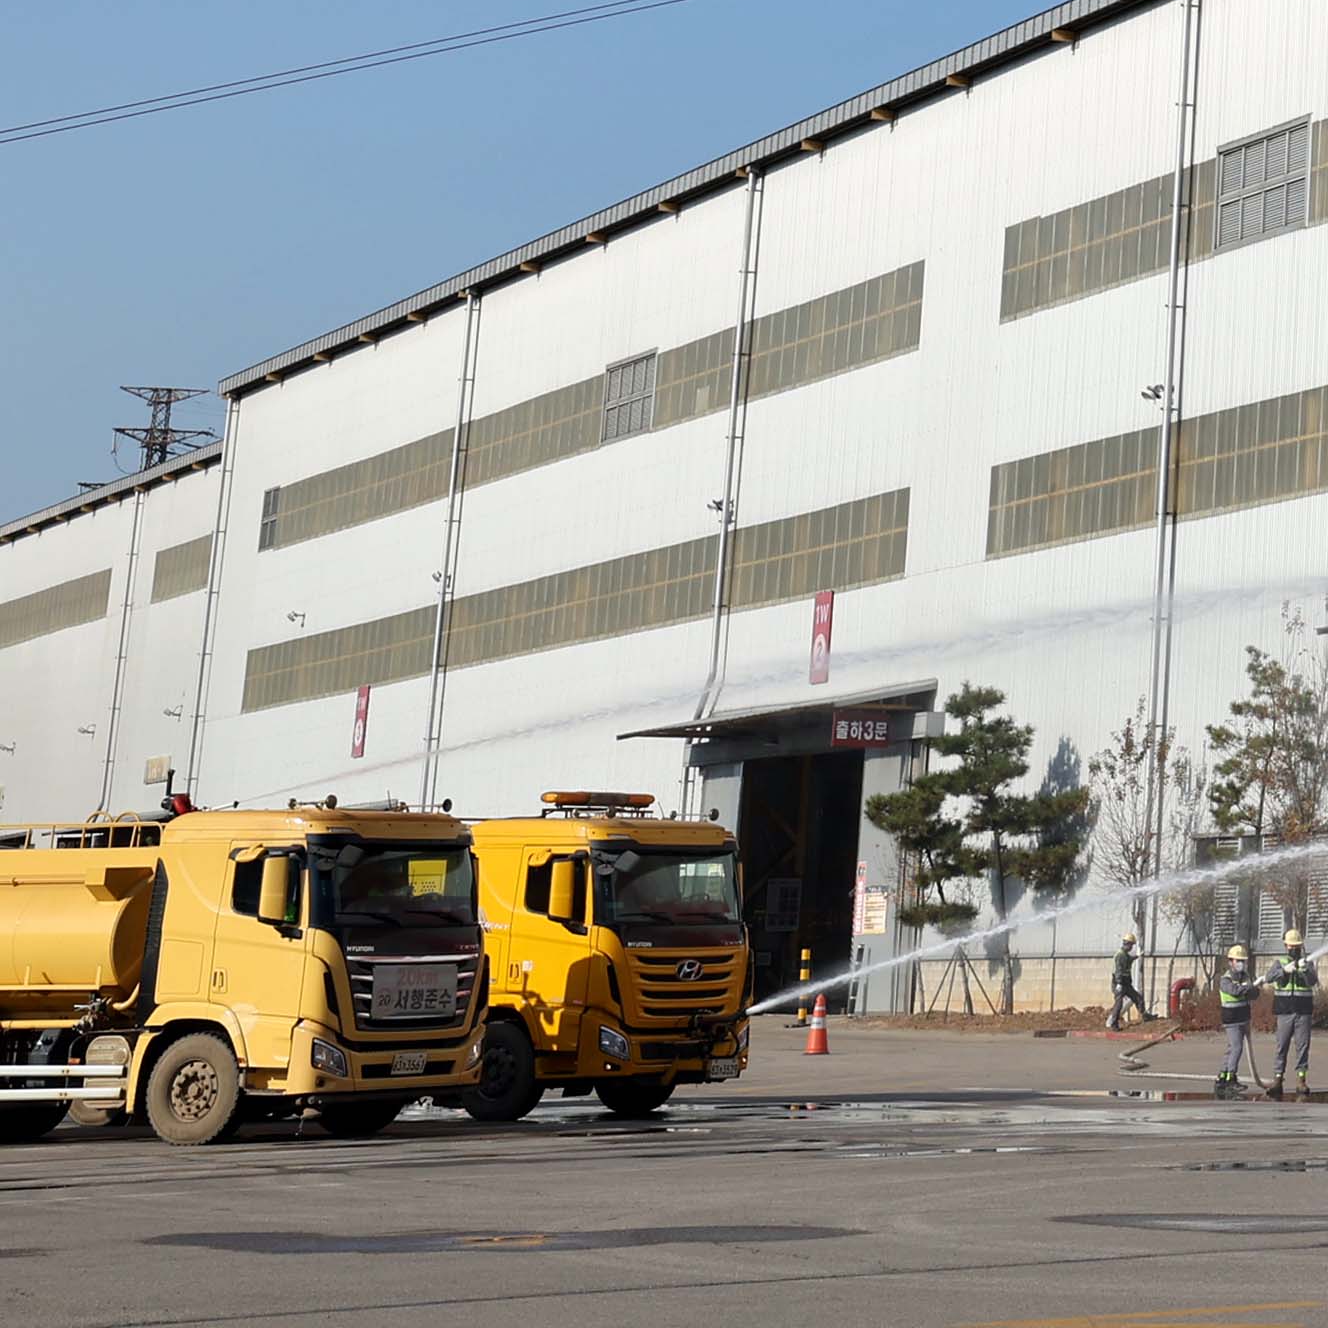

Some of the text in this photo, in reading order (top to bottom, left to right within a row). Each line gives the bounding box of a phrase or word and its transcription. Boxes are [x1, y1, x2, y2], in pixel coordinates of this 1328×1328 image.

[816, 603, 829, 625] 1W
[836, 720, 887, 741] 출하3문
[394, 988, 452, 1010] 서행준수
